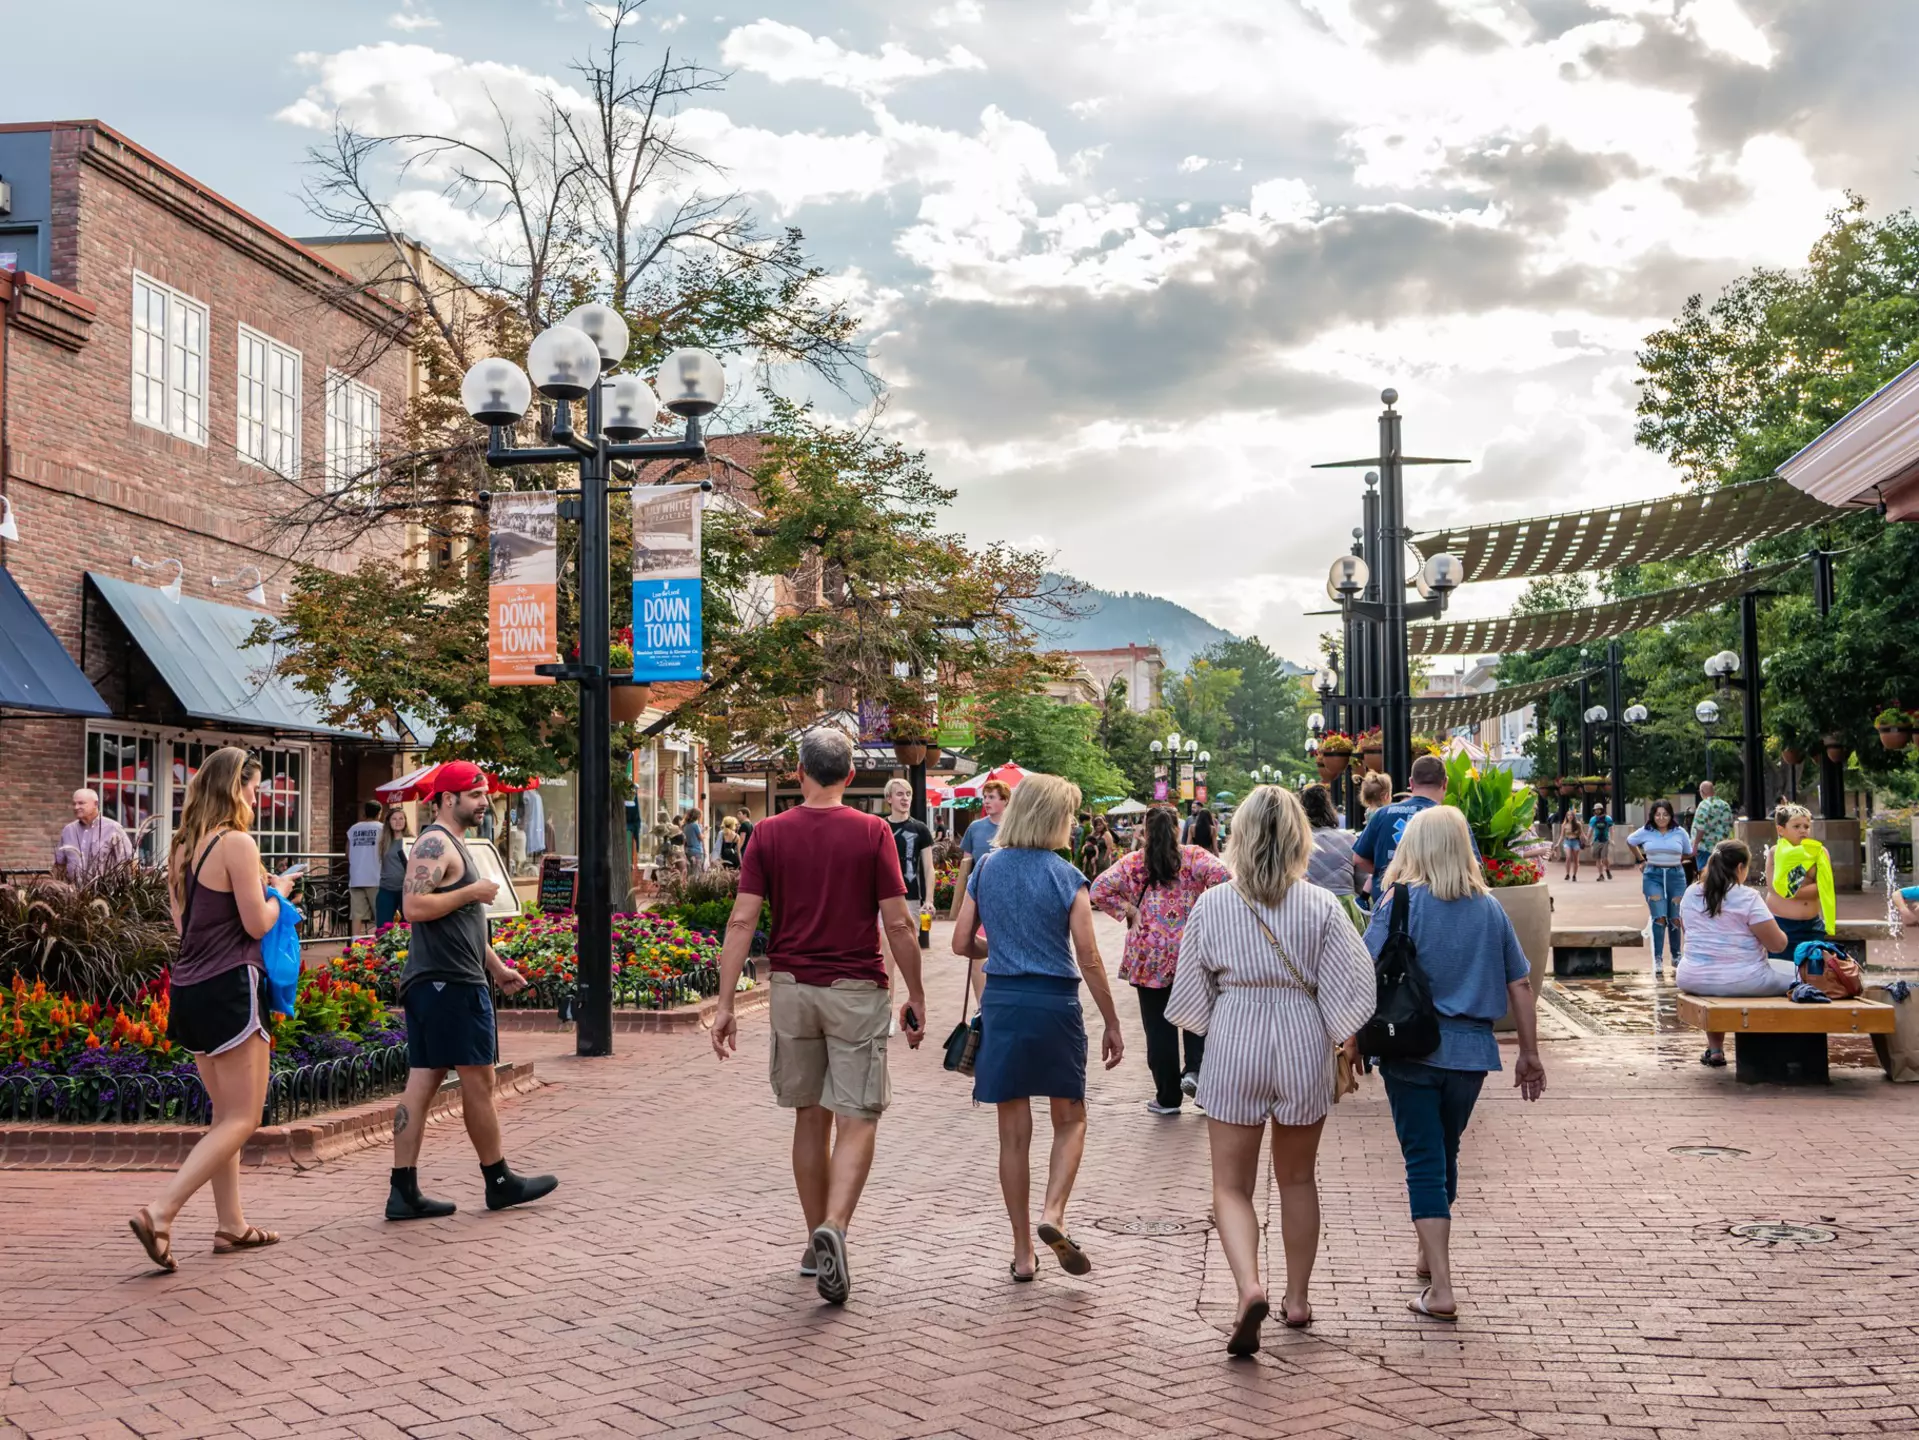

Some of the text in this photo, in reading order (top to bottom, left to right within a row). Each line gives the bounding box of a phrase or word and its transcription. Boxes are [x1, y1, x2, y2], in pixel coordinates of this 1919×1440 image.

[662, 498, 691, 513] WHITE
[500, 602, 545, 627] DOWN
[644, 597, 690, 622] DOWN
[500, 628, 545, 652] TOWN
[644, 623, 690, 648] TOWN
